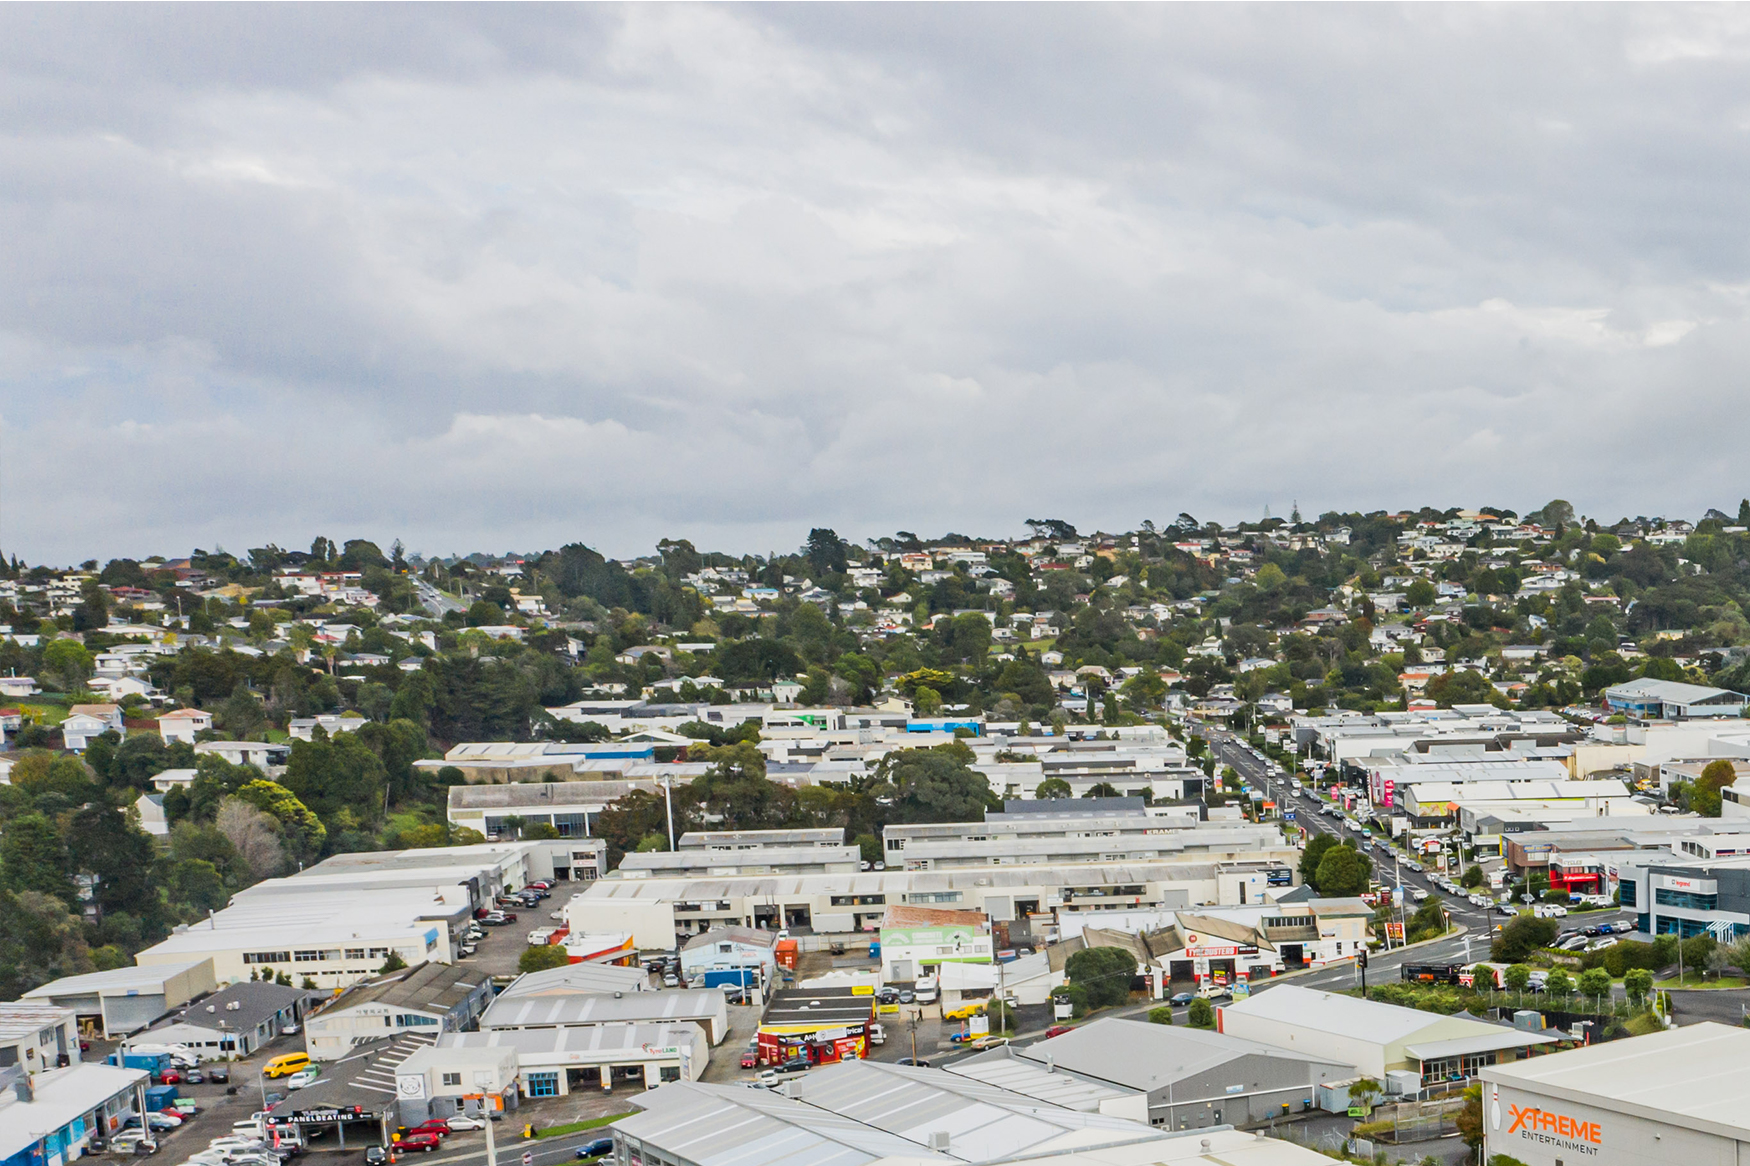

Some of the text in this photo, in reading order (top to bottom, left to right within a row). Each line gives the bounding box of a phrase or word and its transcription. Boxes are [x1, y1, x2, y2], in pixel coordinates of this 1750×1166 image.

[288, 1113, 353, 1123] PANELBEATING
[1508, 1103, 1602, 1144] XTREME
[1522, 1130, 1598, 1157] ENTERTAINMENT
